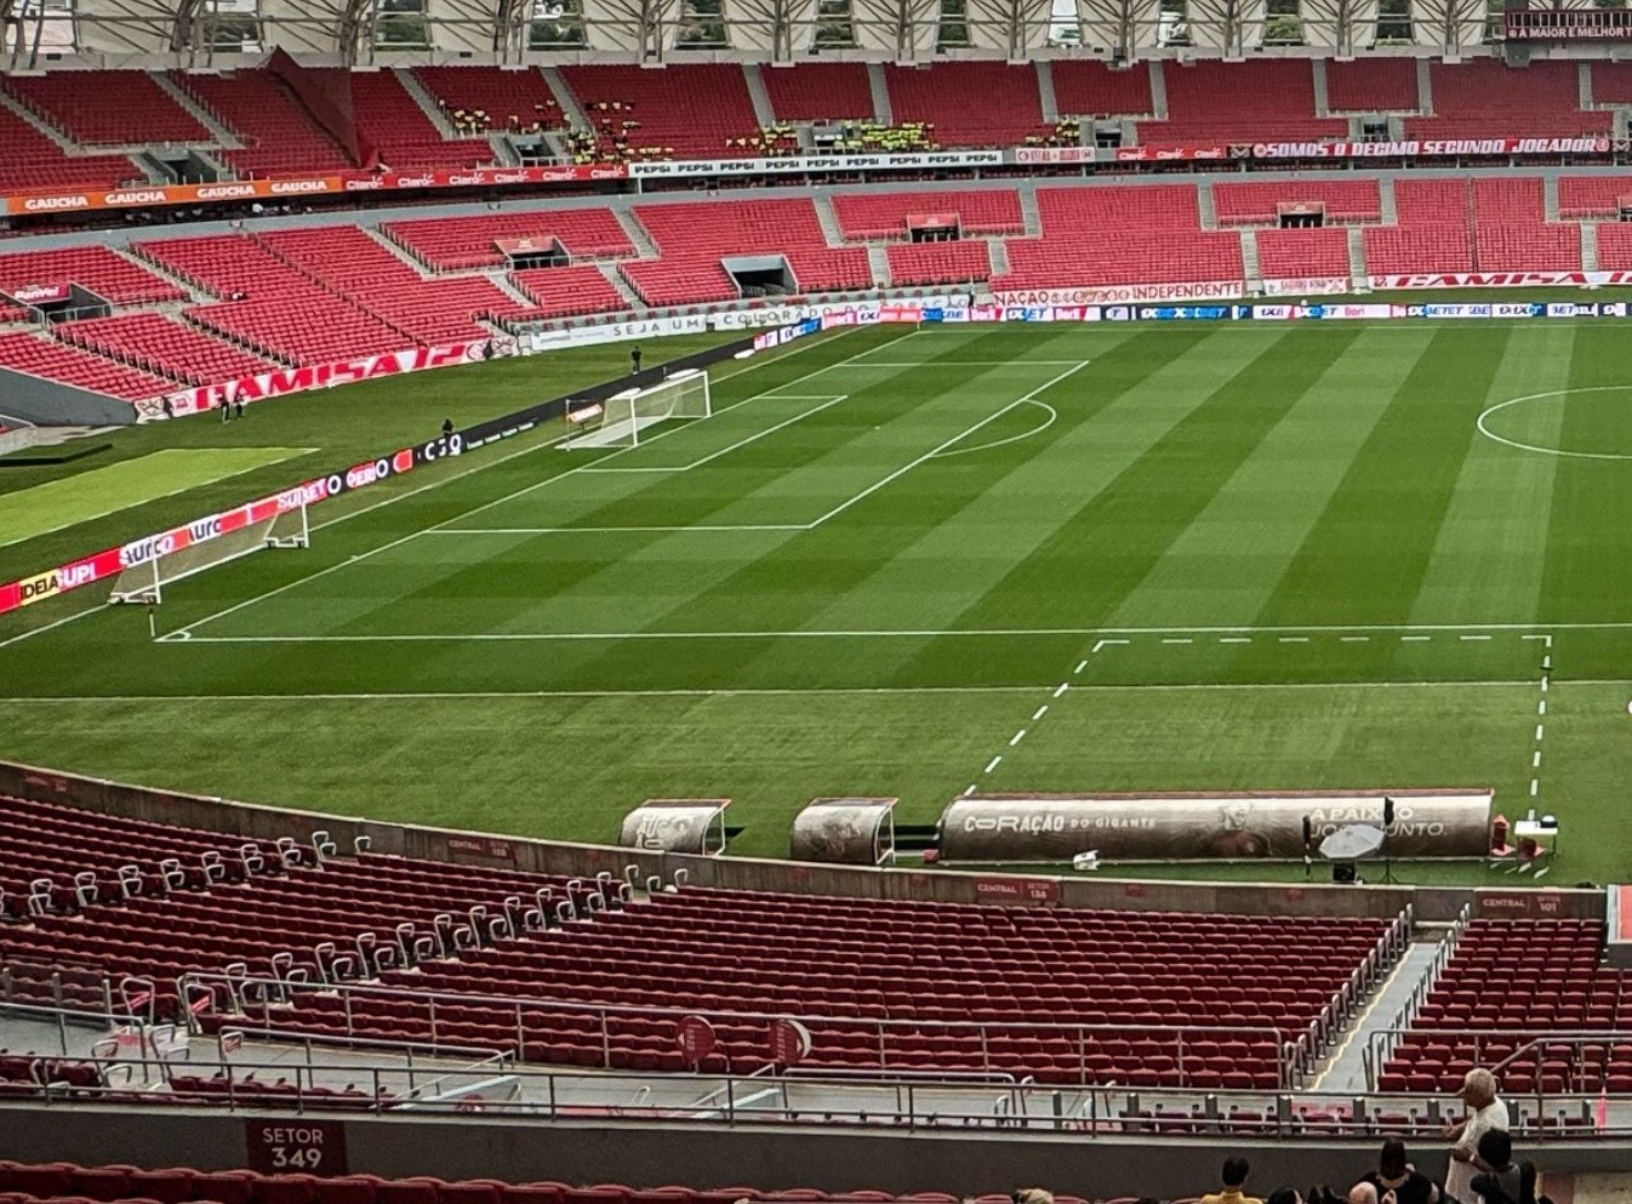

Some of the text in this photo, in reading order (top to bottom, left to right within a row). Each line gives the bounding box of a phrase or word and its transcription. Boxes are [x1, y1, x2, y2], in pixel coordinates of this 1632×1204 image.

[1518, 29, 1528, 38] A
[1529, 28, 1566, 37] MAIOR
[1568, 28, 1576, 37] E
[1577, 27, 1624, 37] MELHOR
[1266, 143, 1329, 157] SOMOS
[1334, 142, 1347, 156] O
[1422, 140, 1506, 154] SEGUNDO
[1512, 139, 1596, 153] JOGADOR
[634, 154, 998, 174] PEPSI PEPSI PEPSI PEPSI PEPSI PEPSI PEPSI PEPSI PEPSI
[346, 167, 620, 190] Claro Claro Claro Claro Claro Claro
[1132, 283, 1241, 300] INDEPENDENTE
[613, 323, 660, 337] SEJA
[672, 319, 699, 330] UM
[1330, 807, 1414, 821] PAIXO
[964, 813, 1157, 836] CORAÇÃO DO GIGANTE
[978, 883, 1017, 893] CENTRAL
[1482, 898, 1525, 907] CENTRAL
[262, 1128, 324, 1144] SETOR
[272, 1147, 322, 1169] 349
